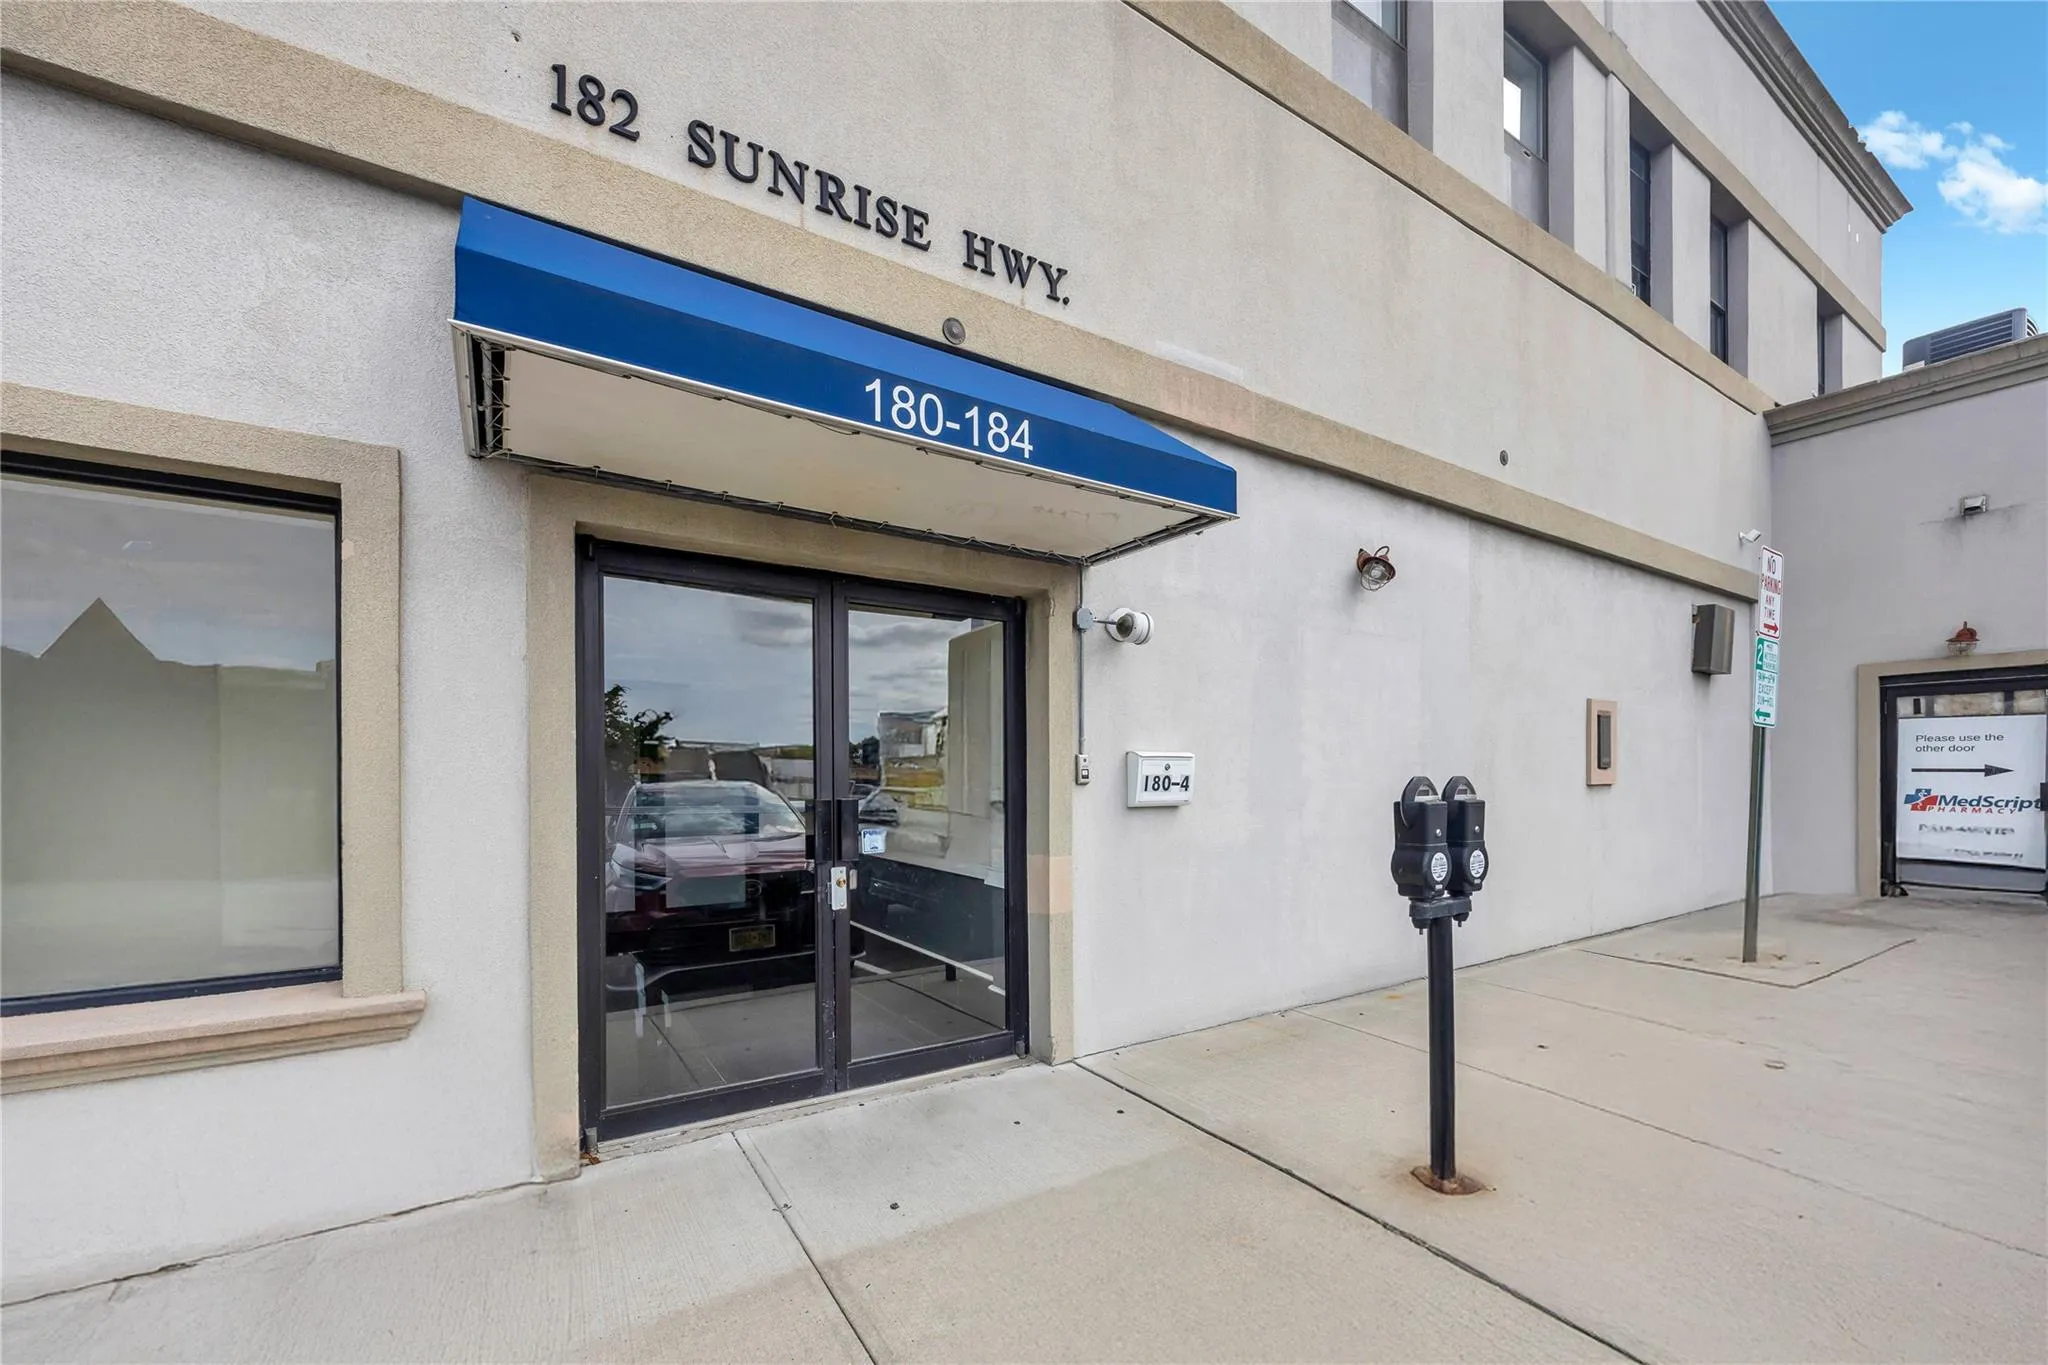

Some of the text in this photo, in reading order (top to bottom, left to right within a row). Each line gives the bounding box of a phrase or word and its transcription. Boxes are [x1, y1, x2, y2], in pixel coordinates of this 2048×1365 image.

[551, 63, 1070, 305] 182 SUNRISE HWY.
[864, 377, 1034, 459] 180-184
[1766, 555, 1777, 575] NO
[1761, 573, 1782, 595] PARKING
[1765, 594, 1775, 606] ANY
[1764, 606, 1776, 621] TIME
[1757, 643, 1763, 665] 2
[1915, 733, 2005, 742] Please use the
[1915, 744, 1976, 752] other door
[1144, 775, 1190, 792] 180-4
[1928, 806, 2016, 815] PHARMACY
[1938, 795, 2041, 812] MedScript
